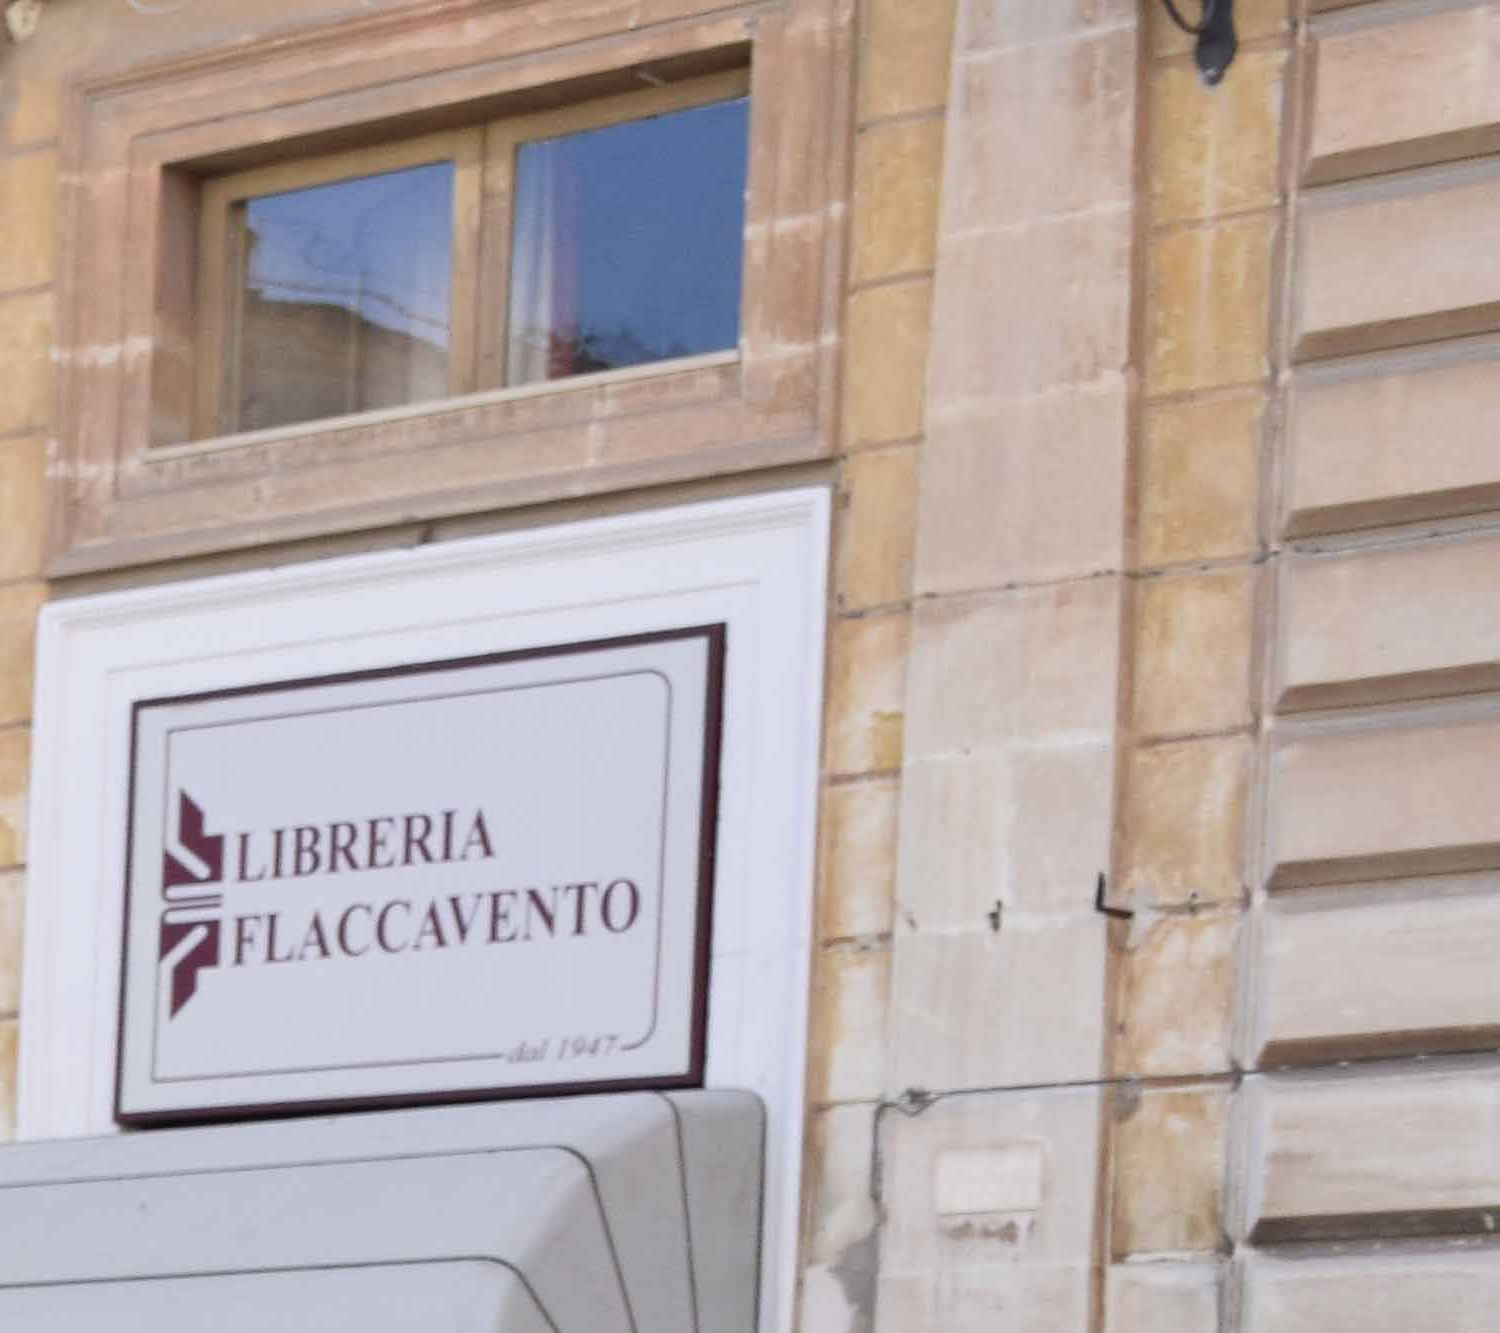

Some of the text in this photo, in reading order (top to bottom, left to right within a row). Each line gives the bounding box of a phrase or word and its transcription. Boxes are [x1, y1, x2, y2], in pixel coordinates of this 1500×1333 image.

[234, 807, 495, 884] LIBRERIA
[232, 879, 640, 967] FLACCAVENTO
[506, 1037, 549, 1063] dal
